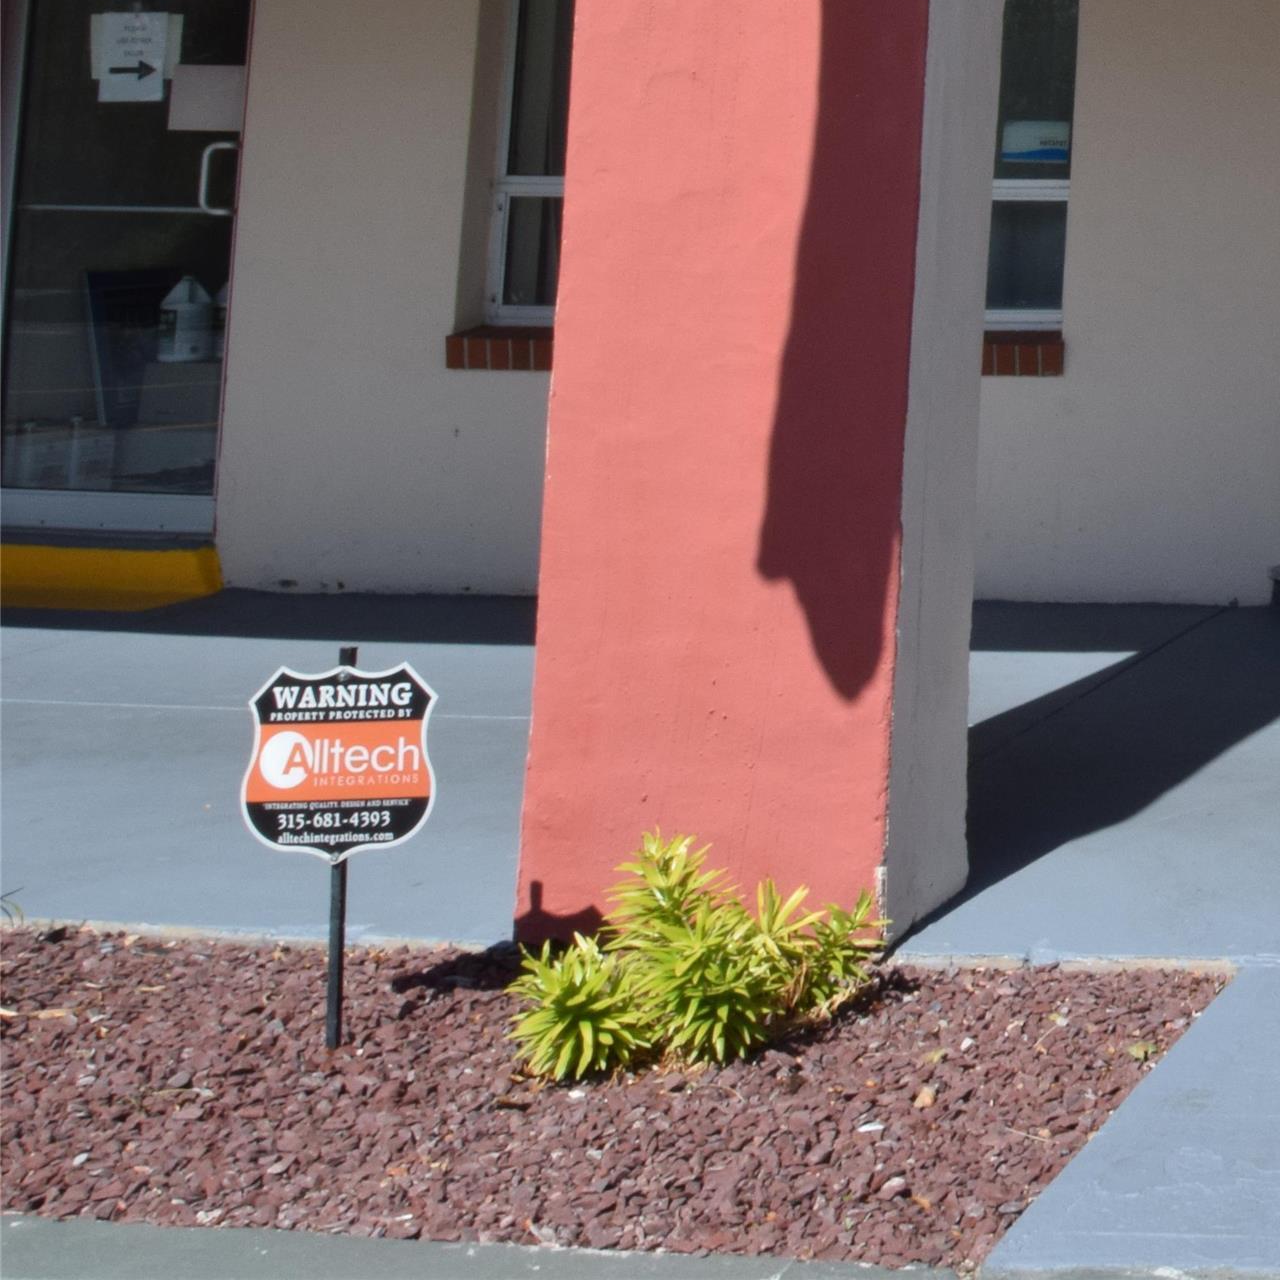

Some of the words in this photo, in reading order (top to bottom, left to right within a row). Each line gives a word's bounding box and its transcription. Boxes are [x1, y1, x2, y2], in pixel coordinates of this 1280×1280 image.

[271, 682, 413, 709] WARNING
[270, 711, 326, 722] PROPERTY
[329, 709, 395, 720] PROTECTED
[398, 707, 413, 718] BY
[278, 735, 420, 776] Alltech
[313, 773, 420, 787] INTEGRATIONS
[277, 810, 391, 830] 315-681-4393
[277, 831, 394, 846] alltechintegrations.com
